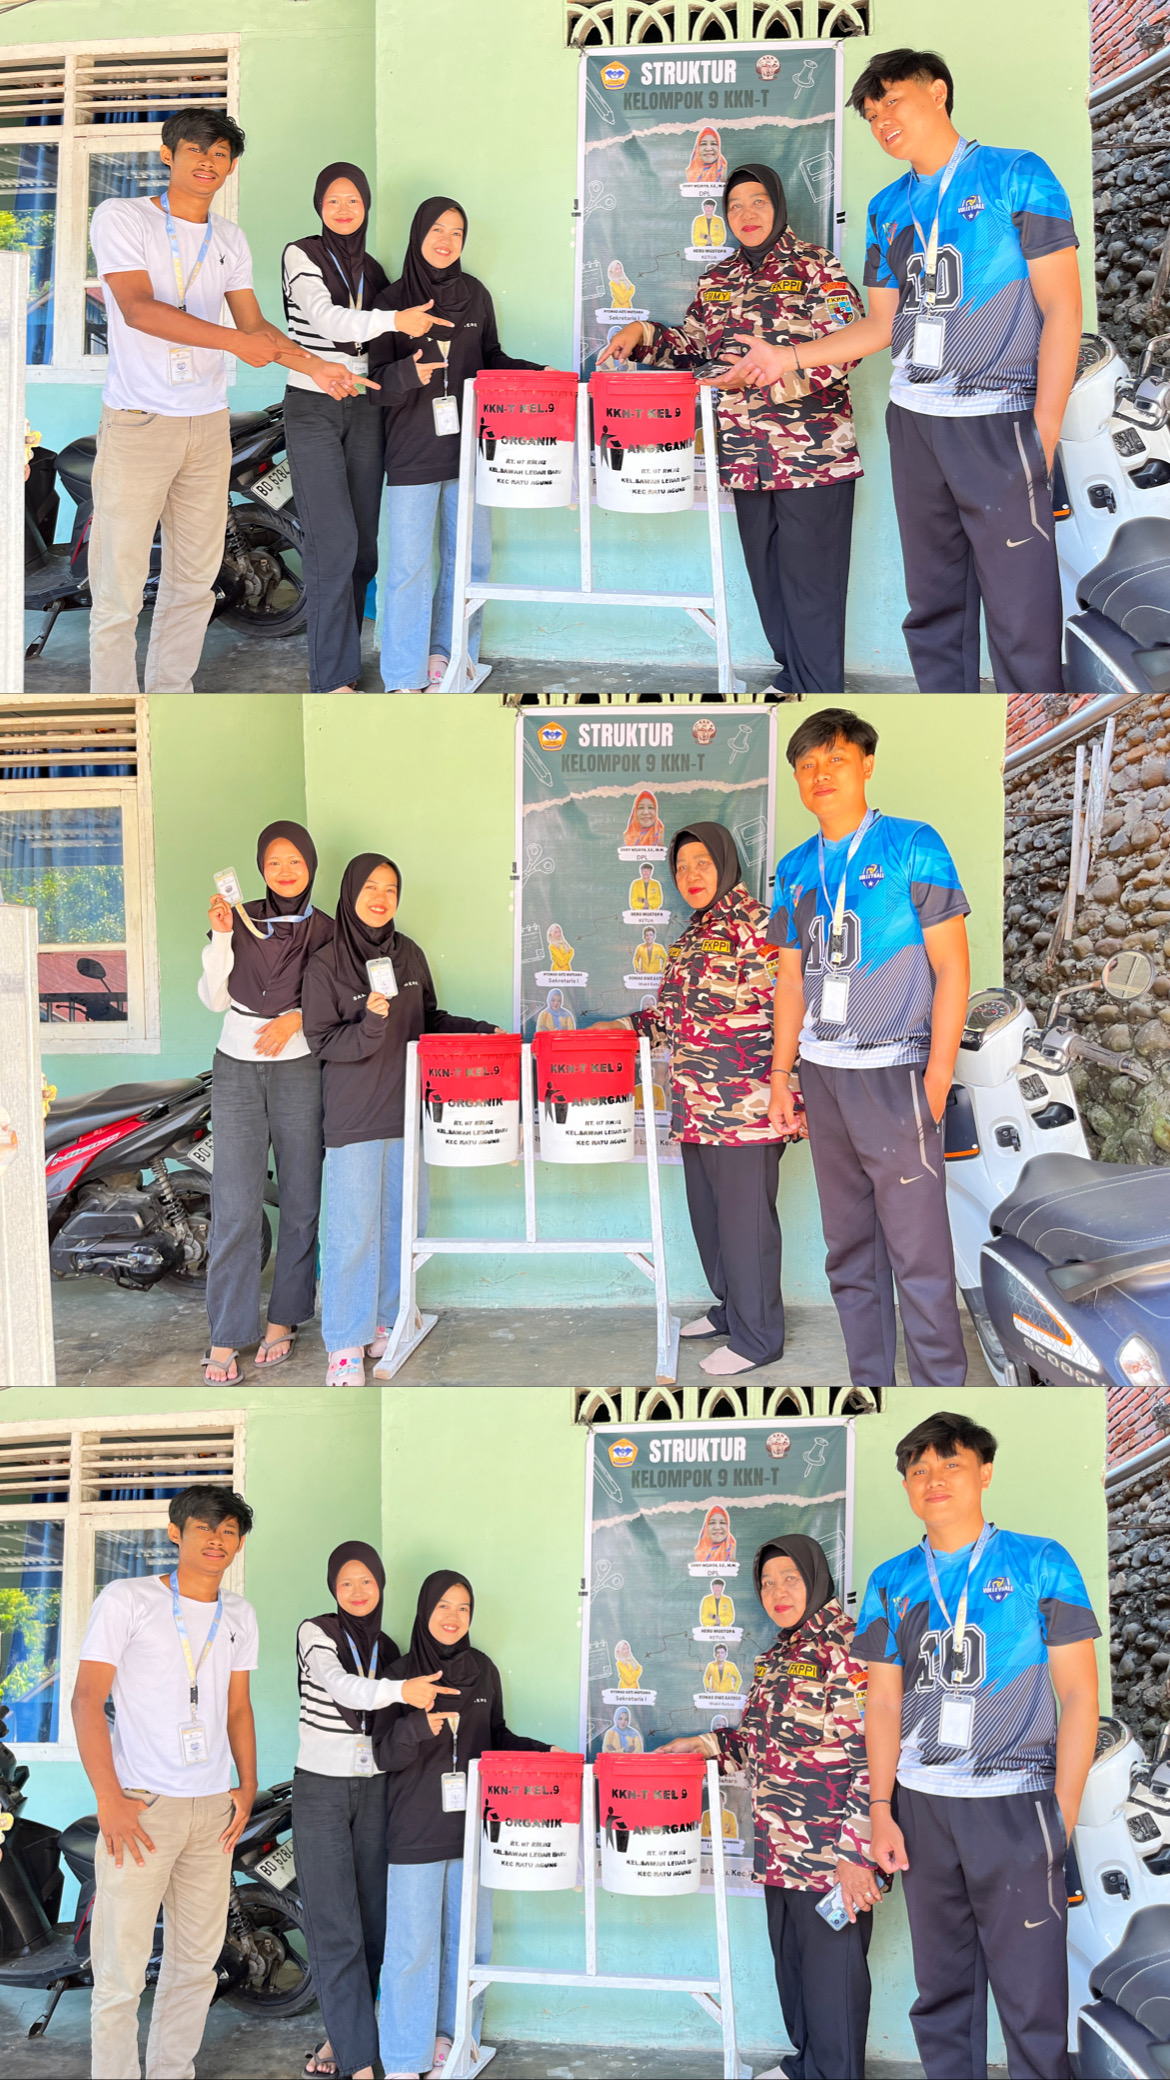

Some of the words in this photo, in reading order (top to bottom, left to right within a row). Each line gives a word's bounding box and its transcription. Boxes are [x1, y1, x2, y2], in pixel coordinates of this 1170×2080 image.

[640, 59, 737, 86] STRUKTUR
[623, 91, 703, 111] KELOMPOK
[708, 91, 719, 109] 9
[723, 89, 770, 109] KKN-T
[771, 280, 800, 292] FKPPI
[903, 243, 963, 315] 10
[483, 404, 516, 413] KKN-T
[519, 403, 555, 413] KEL.9
[606, 408, 644, 418] KKN-T
[500, 435, 558, 446] ORGANIK
[627, 437, 693, 454] ANORGANIK
[256, 481, 274, 496] BD
[578, 722, 674, 747] STRUKTUR
[561, 754, 641, 773] KELOMPOK
[646, 753, 656, 772] 9
[661, 753, 706, 772] KKN-T
[703, 940, 730, 952] FKPPI
[805, 909, 862, 975] 10
[428, 1067, 462, 1078] KKN-T
[465, 1065, 500, 1077] KEL.9
[550, 1064, 588, 1074] KKN-T
[447, 1097, 504, 1108] ORGANIK
[571, 1092, 633, 1107] ANORGANIK
[193, 1147, 211, 1163] BD
[649, 1436, 747, 1463] STRUKTUR
[631, 1469, 712, 1489] KELOMPOK
[717, 1470, 728, 1487] 9
[733, 1467, 780, 1486] KKN-T
[915, 1623, 986, 1693] 10
[789, 1663, 816, 1676] FKPPI
[487, 1785, 521, 1795] KKN-T
[524, 1785, 560, 1795] KEL.9
[611, 1789, 650, 1800] KKN-T
[505, 1818, 562, 1828] ORGANIK
[633, 1820, 699, 1836] ANORGANIK
[260, 1860, 278, 1876] BD
